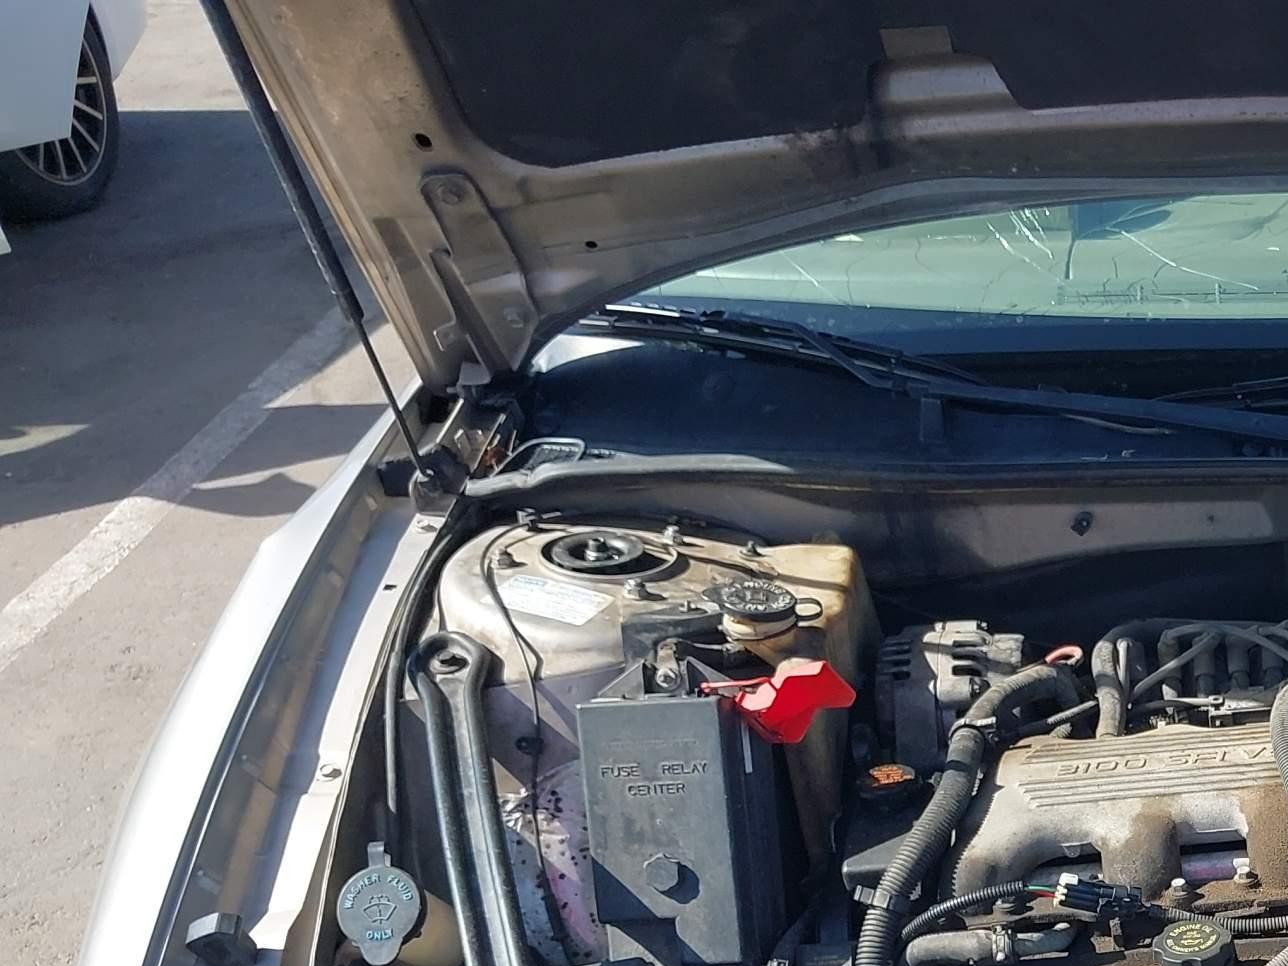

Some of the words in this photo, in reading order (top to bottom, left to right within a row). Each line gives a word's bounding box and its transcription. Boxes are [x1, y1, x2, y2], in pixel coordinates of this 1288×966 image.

[601, 762, 640, 778] FUSE
[661, 761, 708, 776] RELAY
[1057, 754, 1148, 776] 3100
[627, 781, 686, 797] CENTER
[343, 873, 382, 910] WASHER
[386, 874, 414, 902] FLUID
[366, 928, 394, 940] ONLY
[1169, 924, 1202, 937] ENGINE
